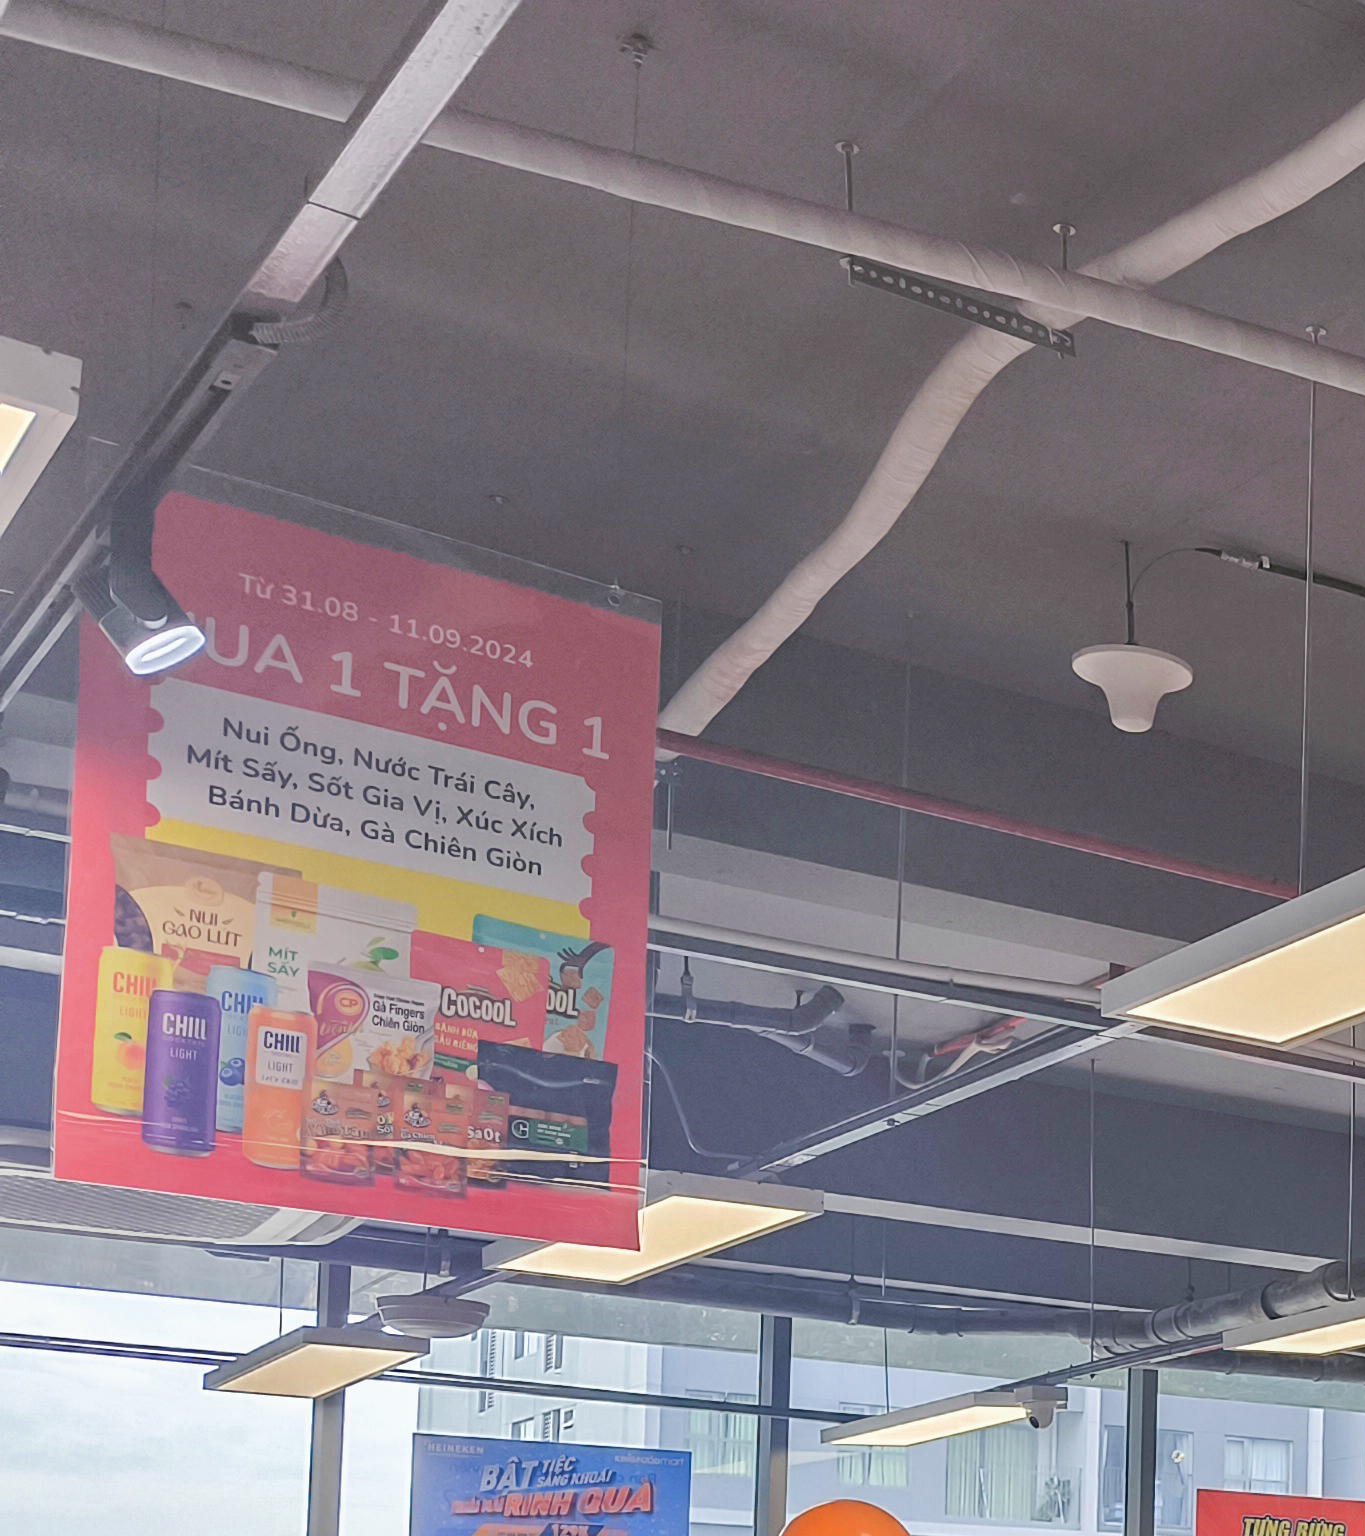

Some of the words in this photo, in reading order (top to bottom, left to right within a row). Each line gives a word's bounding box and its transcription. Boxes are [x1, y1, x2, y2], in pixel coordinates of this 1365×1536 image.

[238, 571, 273, 601] Từ
[281, 586, 359, 621] 31.08
[389, 614, 534, 668] 11.09.2024
[189, 613, 302, 684] UA
[330, 651, 361, 697] 1
[384, 660, 558, 745] TẶNG
[582, 716, 610, 759] 1
[223, 718, 271, 745] Nui
[279, 723, 343, 767] Ống,
[353, 748, 420, 782] Nước
[428, 763, 477, 796] Trái
[484, 778, 535, 811] Cây,
[187, 745, 232, 774] Mít
[242, 752, 299, 791] Sấy,
[308, 770, 354, 799] Sốt
[362, 782, 405, 811] Gia
[413, 796, 447, 826] Vị,
[455, 805, 502, 835] Xúc
[511, 815, 562, 847] Xích
[208, 786, 281, 819] Bánh
[290, 802, 351, 838] Dừa,
[360, 818, 396, 845] Gà
[404, 829, 478, 862] Chiên
[485, 845, 542, 876] Giòn
[189, 909, 218, 926] NUI
[269, 947, 298, 962] MÍT
[268, 962, 299, 977] SẤY
[372, 1001, 386, 1014] Gà
[389, 1002, 425, 1020] Fingers
[163, 1013, 207, 1040] CHILL
[263, 1031, 301, 1053] CHILL
[170, 1048, 197, 1060] LIGHT
[268, 1061, 293, 1074] LIGHT
[427, 1443, 484, 1454] HEINEKEN
[480, 1456, 540, 1496] BẬT
[504, 1492, 576, 1516] RINH
